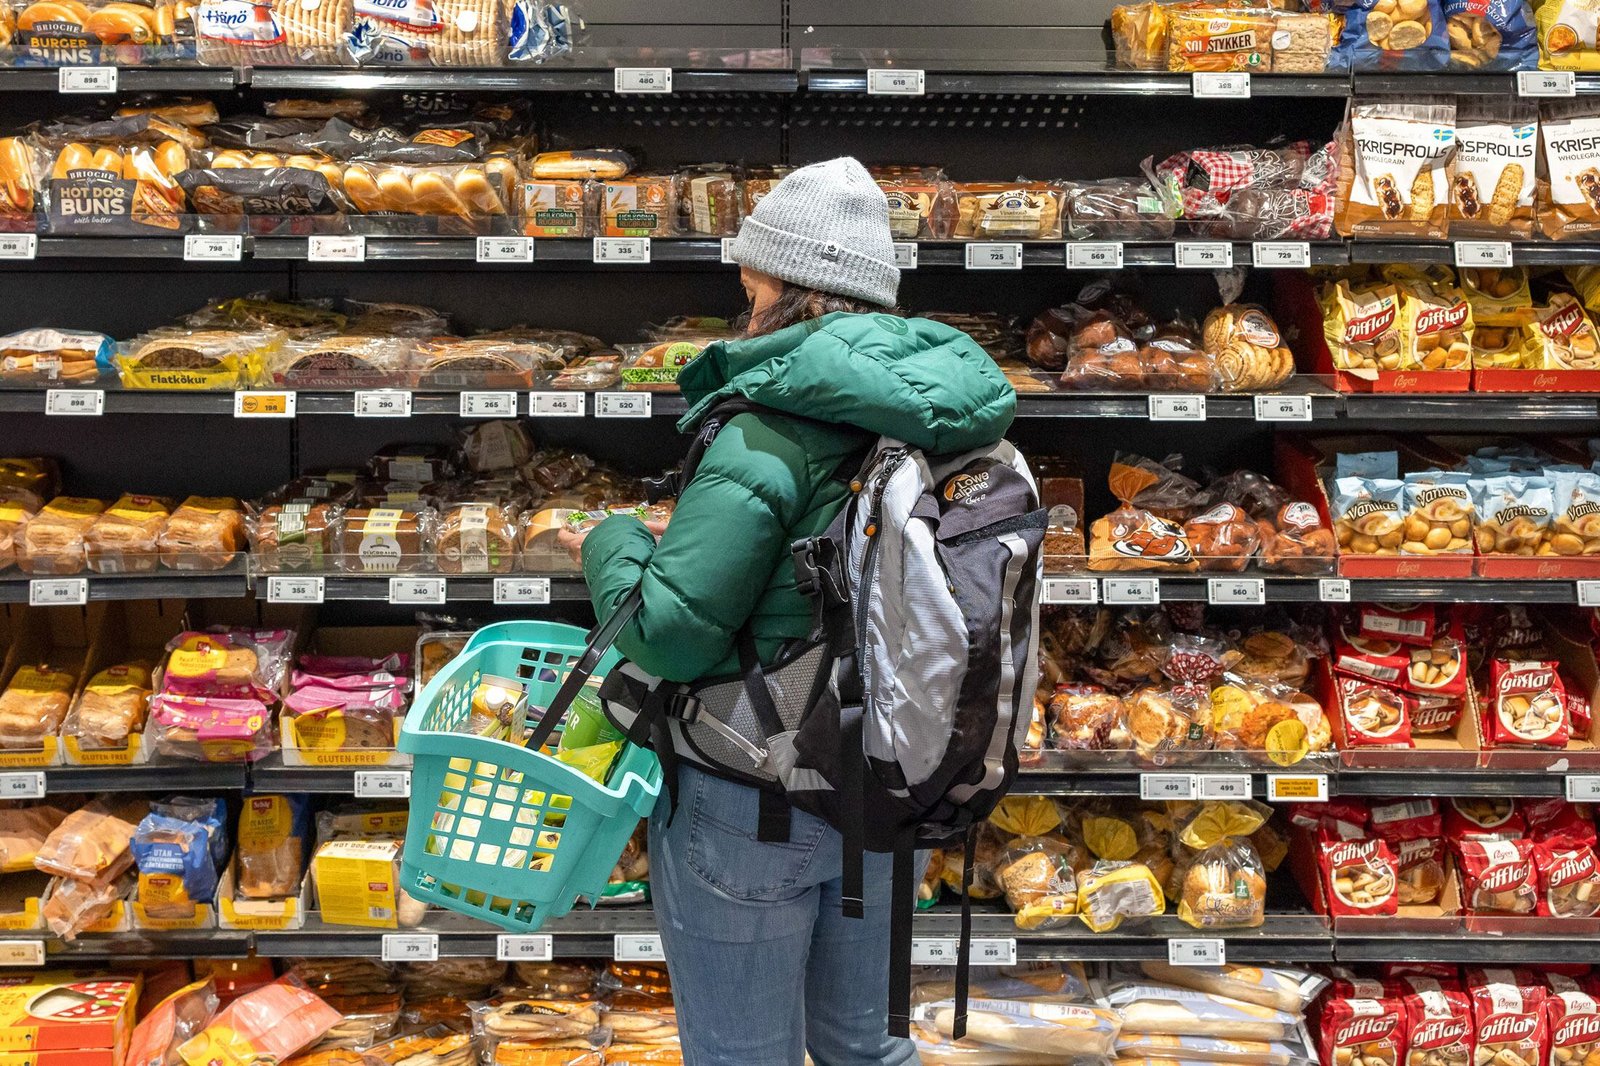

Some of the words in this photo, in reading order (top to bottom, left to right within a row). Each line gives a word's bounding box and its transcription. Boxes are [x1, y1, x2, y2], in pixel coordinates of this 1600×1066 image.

[36, 22, 80, 33] BRIOCHE
[31, 38, 87, 49] BURGER
[1208, 34, 1252, 53] STYKKER
[1358, 139, 1449, 159] KRISPROLLS
[1457, 140, 1533, 158] ISPROLLS
[1361, 155, 1405, 165] WHOLEGRAIN
[70, 169, 115, 180] BRIOCHE
[60, 187, 89, 199] HOT
[93, 187, 125, 198] DOG
[61, 201, 126, 216] BUNS
[1091, 252, 1105, 260] 569
[1200, 252, 1214, 260] 729
[1278, 252, 1292, 260] 729
[1345, 309, 1393, 341] gifflar
[1417, 306, 1467, 333] gifflar
[150, 373, 207, 385] Flatkökur
[70, 399, 85, 407] 898
[956, 471, 989, 489] Lowe
[953, 481, 989, 500] alpine
[1417, 487, 1467, 507] Vanillas
[1348, 501, 1398, 521] Vanillas
[1496, 505, 1547, 525] Vanillas
[291, 587, 306, 595] 355
[413, 587, 428, 595] 340
[1066, 588, 1080, 596] 635
[1127, 588, 1142, 596] 645
[1233, 588, 1247, 596] 560
[1501, 673, 1553, 693] gifflar
[1164, 784, 1179, 792] 499
[1219, 784, 1234, 792] 499
[153, 848, 173, 857] UTAN
[1333, 839, 1376, 866] gifflar
[1551, 855, 1592, 886] gifflar
[1482, 863, 1527, 891] gifflar
[520, 944, 534, 952] 699
[638, 944, 652, 952] 635
[930, 949, 942, 957] 510
[984, 949, 998, 957] 595
[1337, 1016, 1394, 1045] gifflar
[1412, 1022, 1465, 1047] gifflar
[1480, 1016, 1532, 1042] gifflar
[1556, 1017, 1600, 1045] giffla
